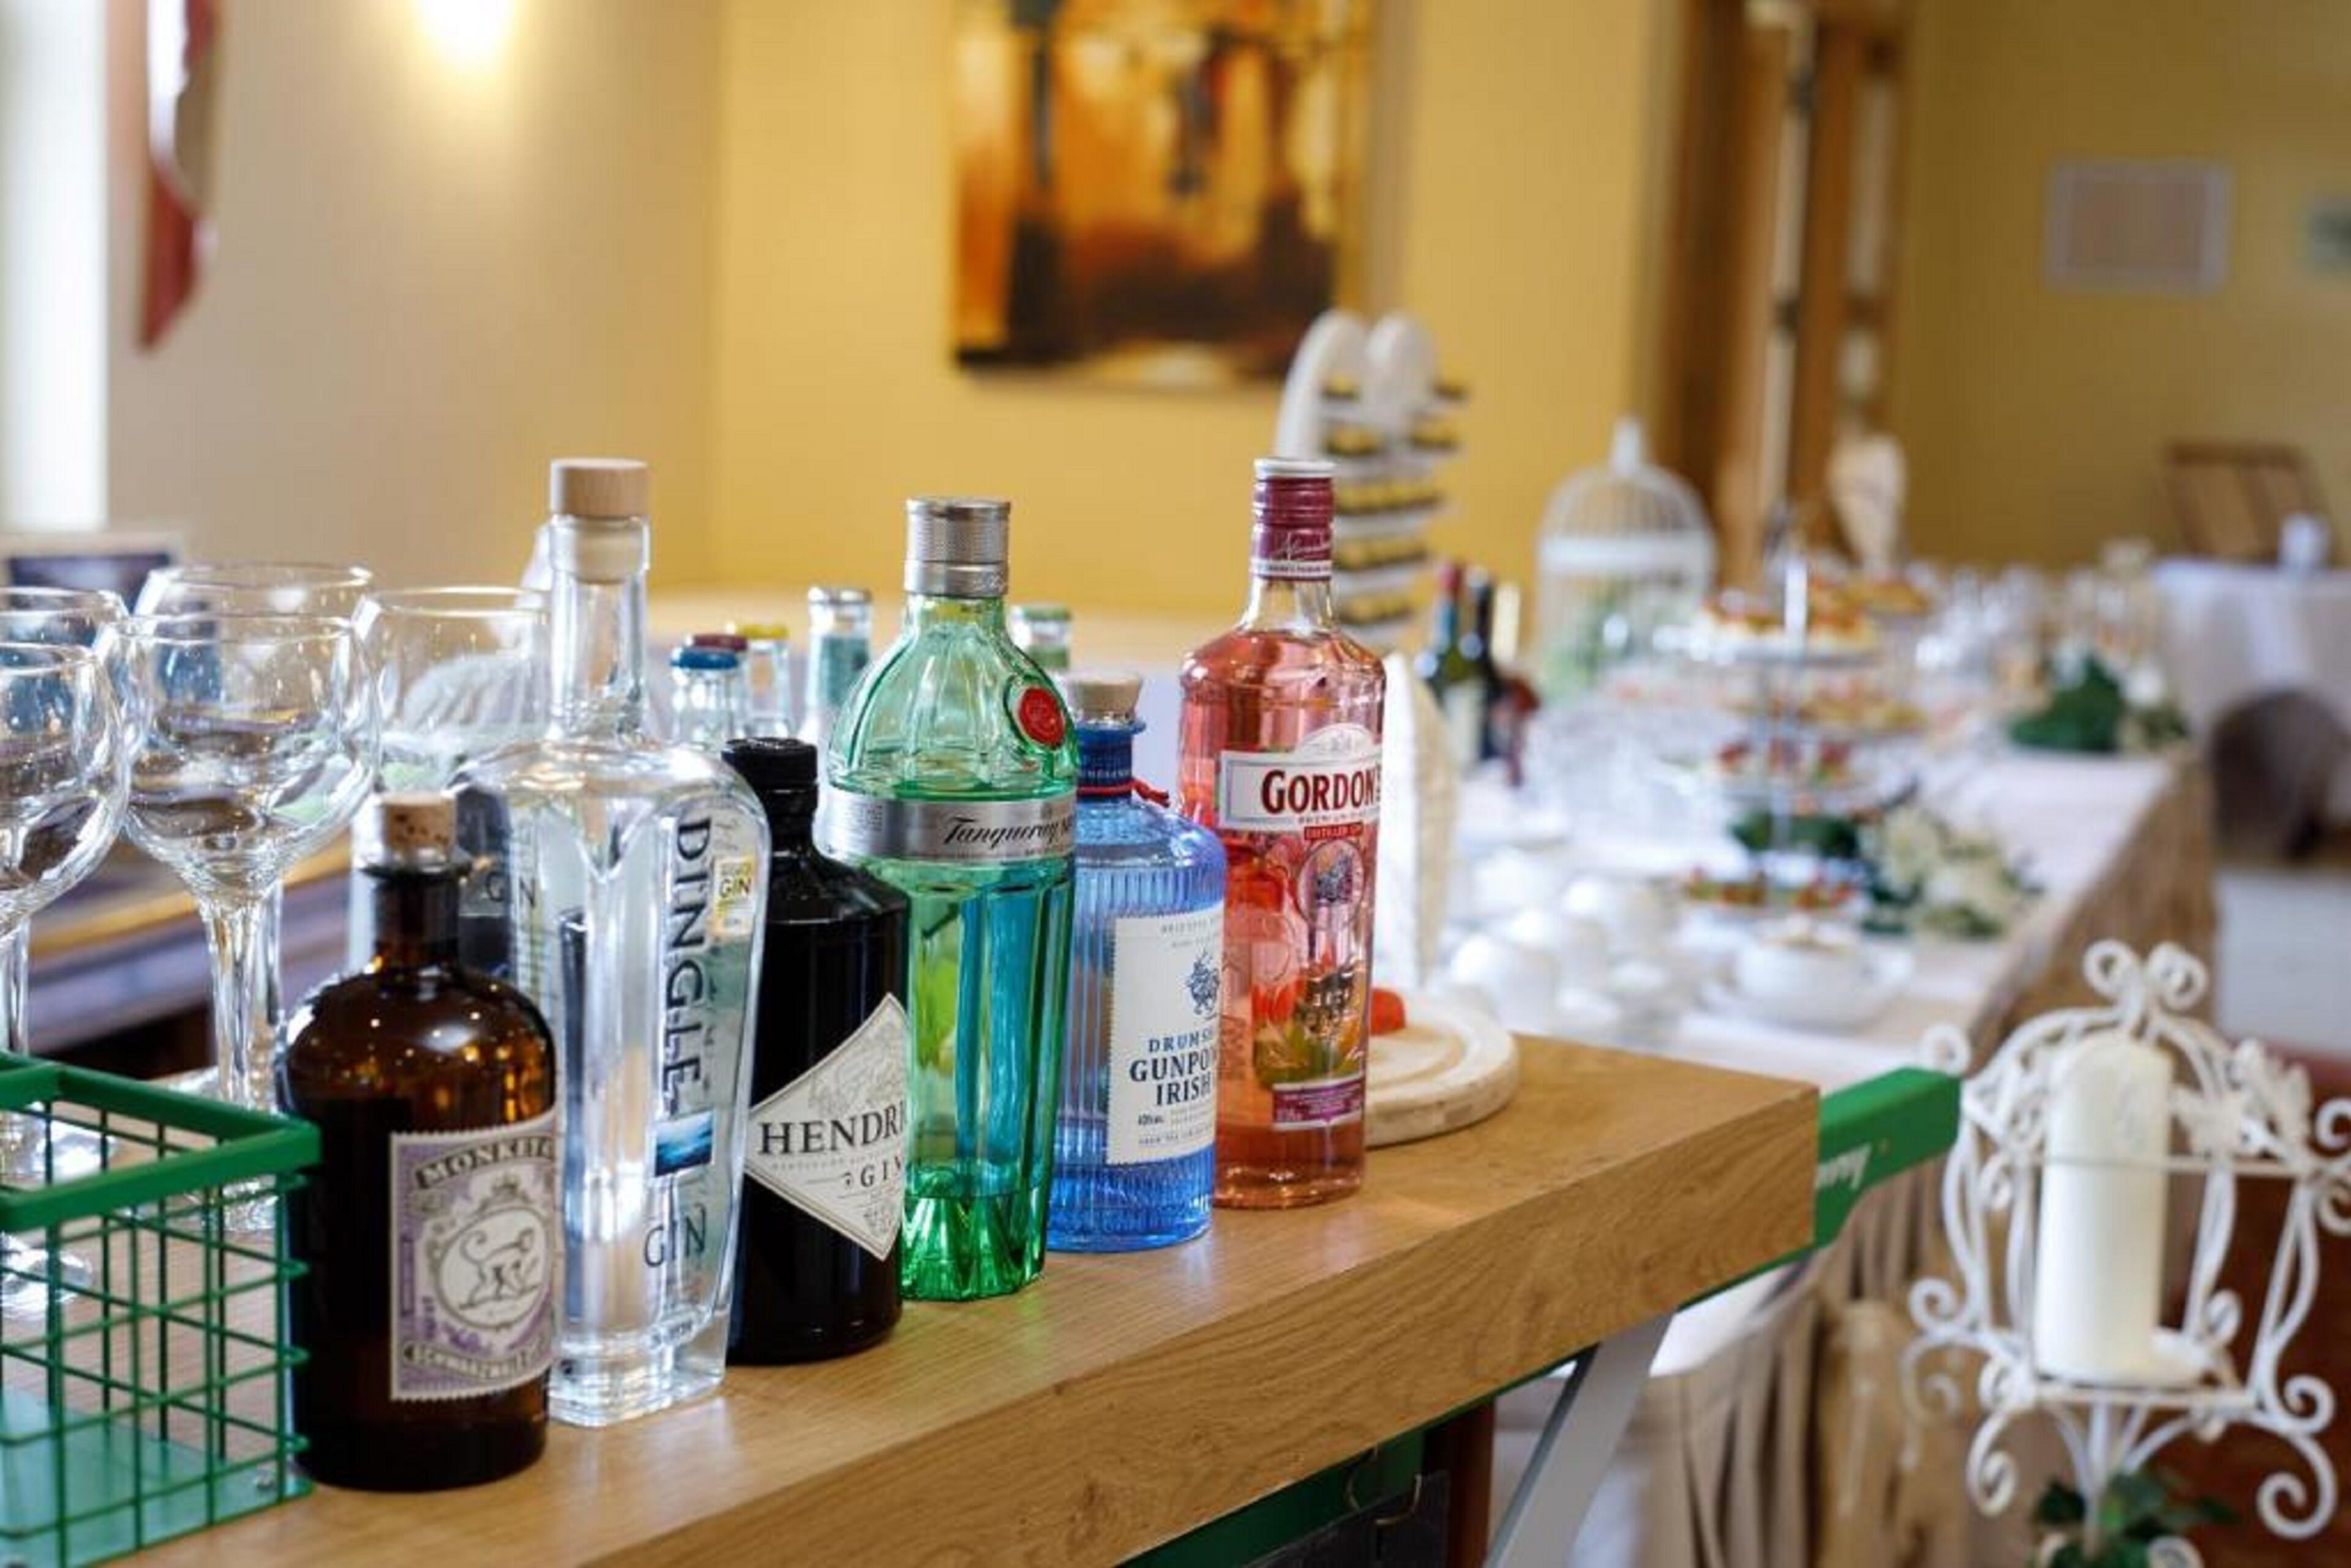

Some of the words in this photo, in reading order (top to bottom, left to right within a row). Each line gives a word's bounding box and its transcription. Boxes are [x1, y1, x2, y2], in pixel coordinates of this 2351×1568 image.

[945, 816, 1059, 848] Tanqueray
[663, 818, 712, 1092] DINGLE
[1157, 1071, 1212, 1106] IRISH
[644, 1202, 707, 1267] GIN
